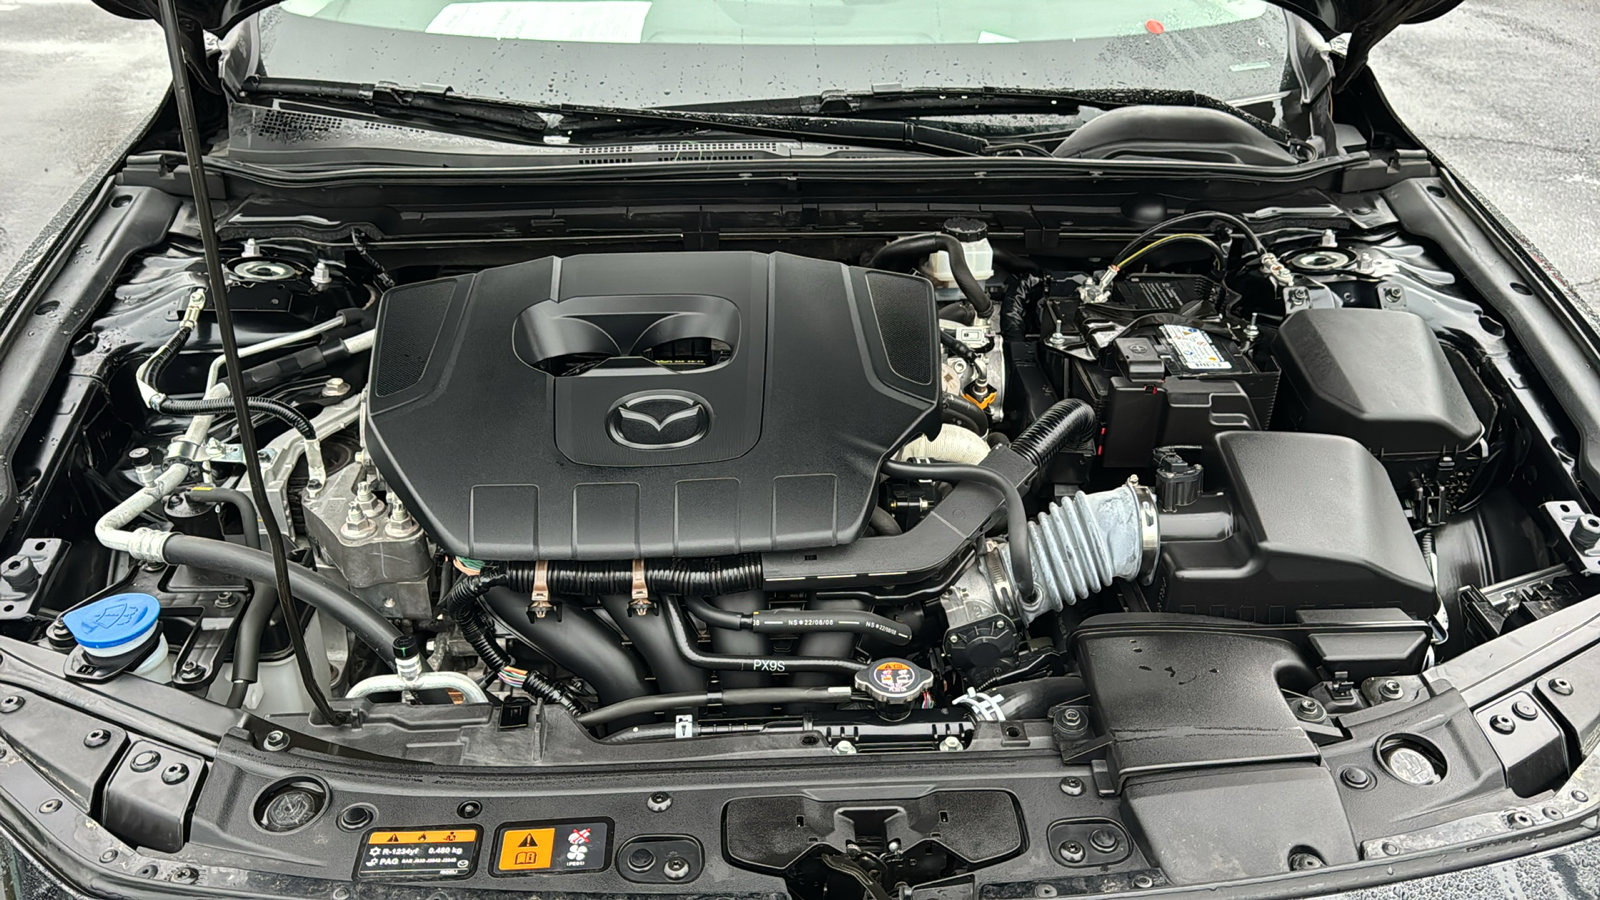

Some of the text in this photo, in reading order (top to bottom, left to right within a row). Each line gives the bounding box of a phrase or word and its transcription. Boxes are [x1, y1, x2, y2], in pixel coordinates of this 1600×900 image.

[753, 659, 785, 672] PX9S
[382, 847, 420, 856] R-1234yf
[451, 846, 463, 855] kg
[379, 857, 399, 866] PAG
